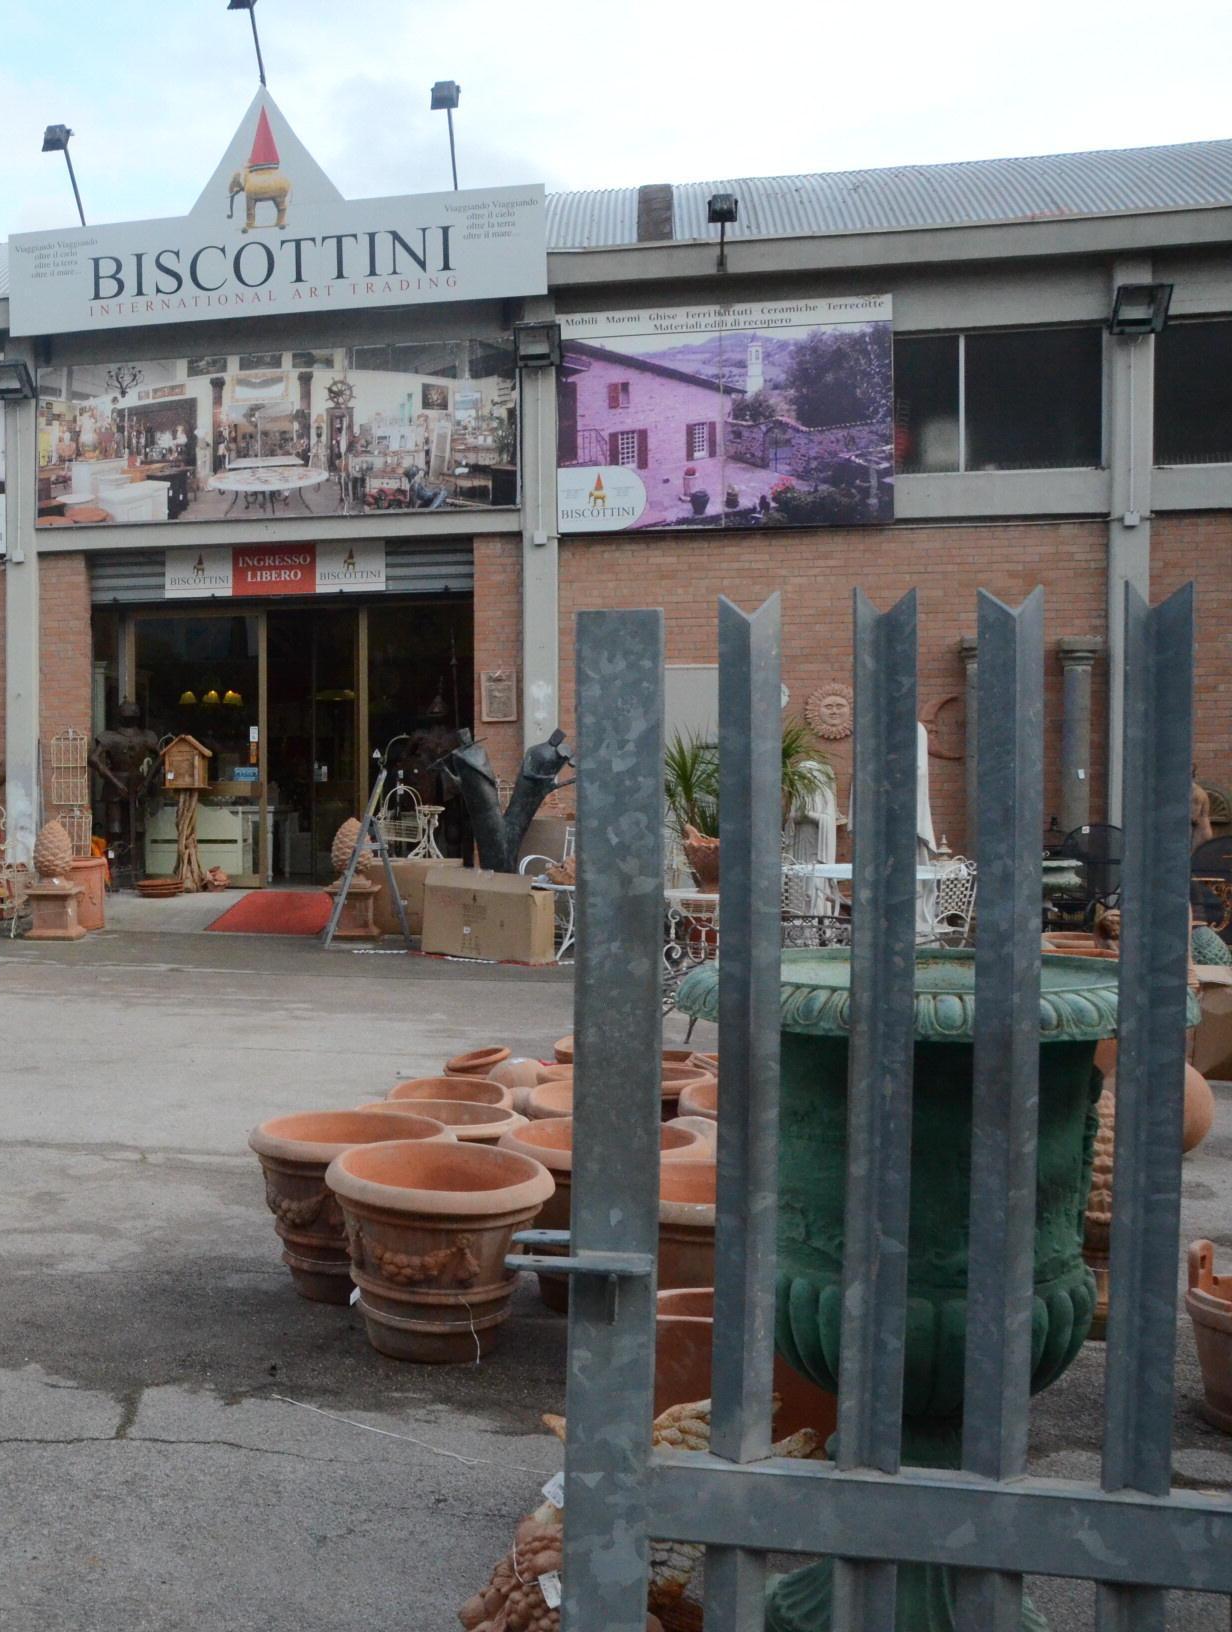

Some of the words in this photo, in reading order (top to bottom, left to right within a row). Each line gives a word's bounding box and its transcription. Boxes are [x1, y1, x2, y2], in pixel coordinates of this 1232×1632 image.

[492, 198, 538, 209] Viaggiando
[497, 220, 516, 228] terra
[88, 225, 456, 300] BISCOTTINI
[90, 290, 276, 317] INTERNATIONAL
[293, 285, 334, 299] ART
[351, 276, 457, 296] TRADING
[565, 316, 598, 327] Mobili
[606, 313, 640, 324] Marmi
[649, 312, 677, 321] Ghise
[685, 310, 711, 320] Ferri
[761, 303, 818, 315] Ceramiche
[827, 300, 884, 311] Terrecotte
[654, 320, 701, 332] Materiali
[704, 319, 727, 329] edili
[730, 317, 740, 327] di
[743, 317, 792, 329] recupero
[561, 506, 635, 519] BISCOTTINI
[238, 554, 310, 567] INGRESSO
[170, 575, 229, 586] BISCOTTINI
[247, 569, 302, 582] LIBERO
[319, 570, 382, 581] BISCOTTINI
